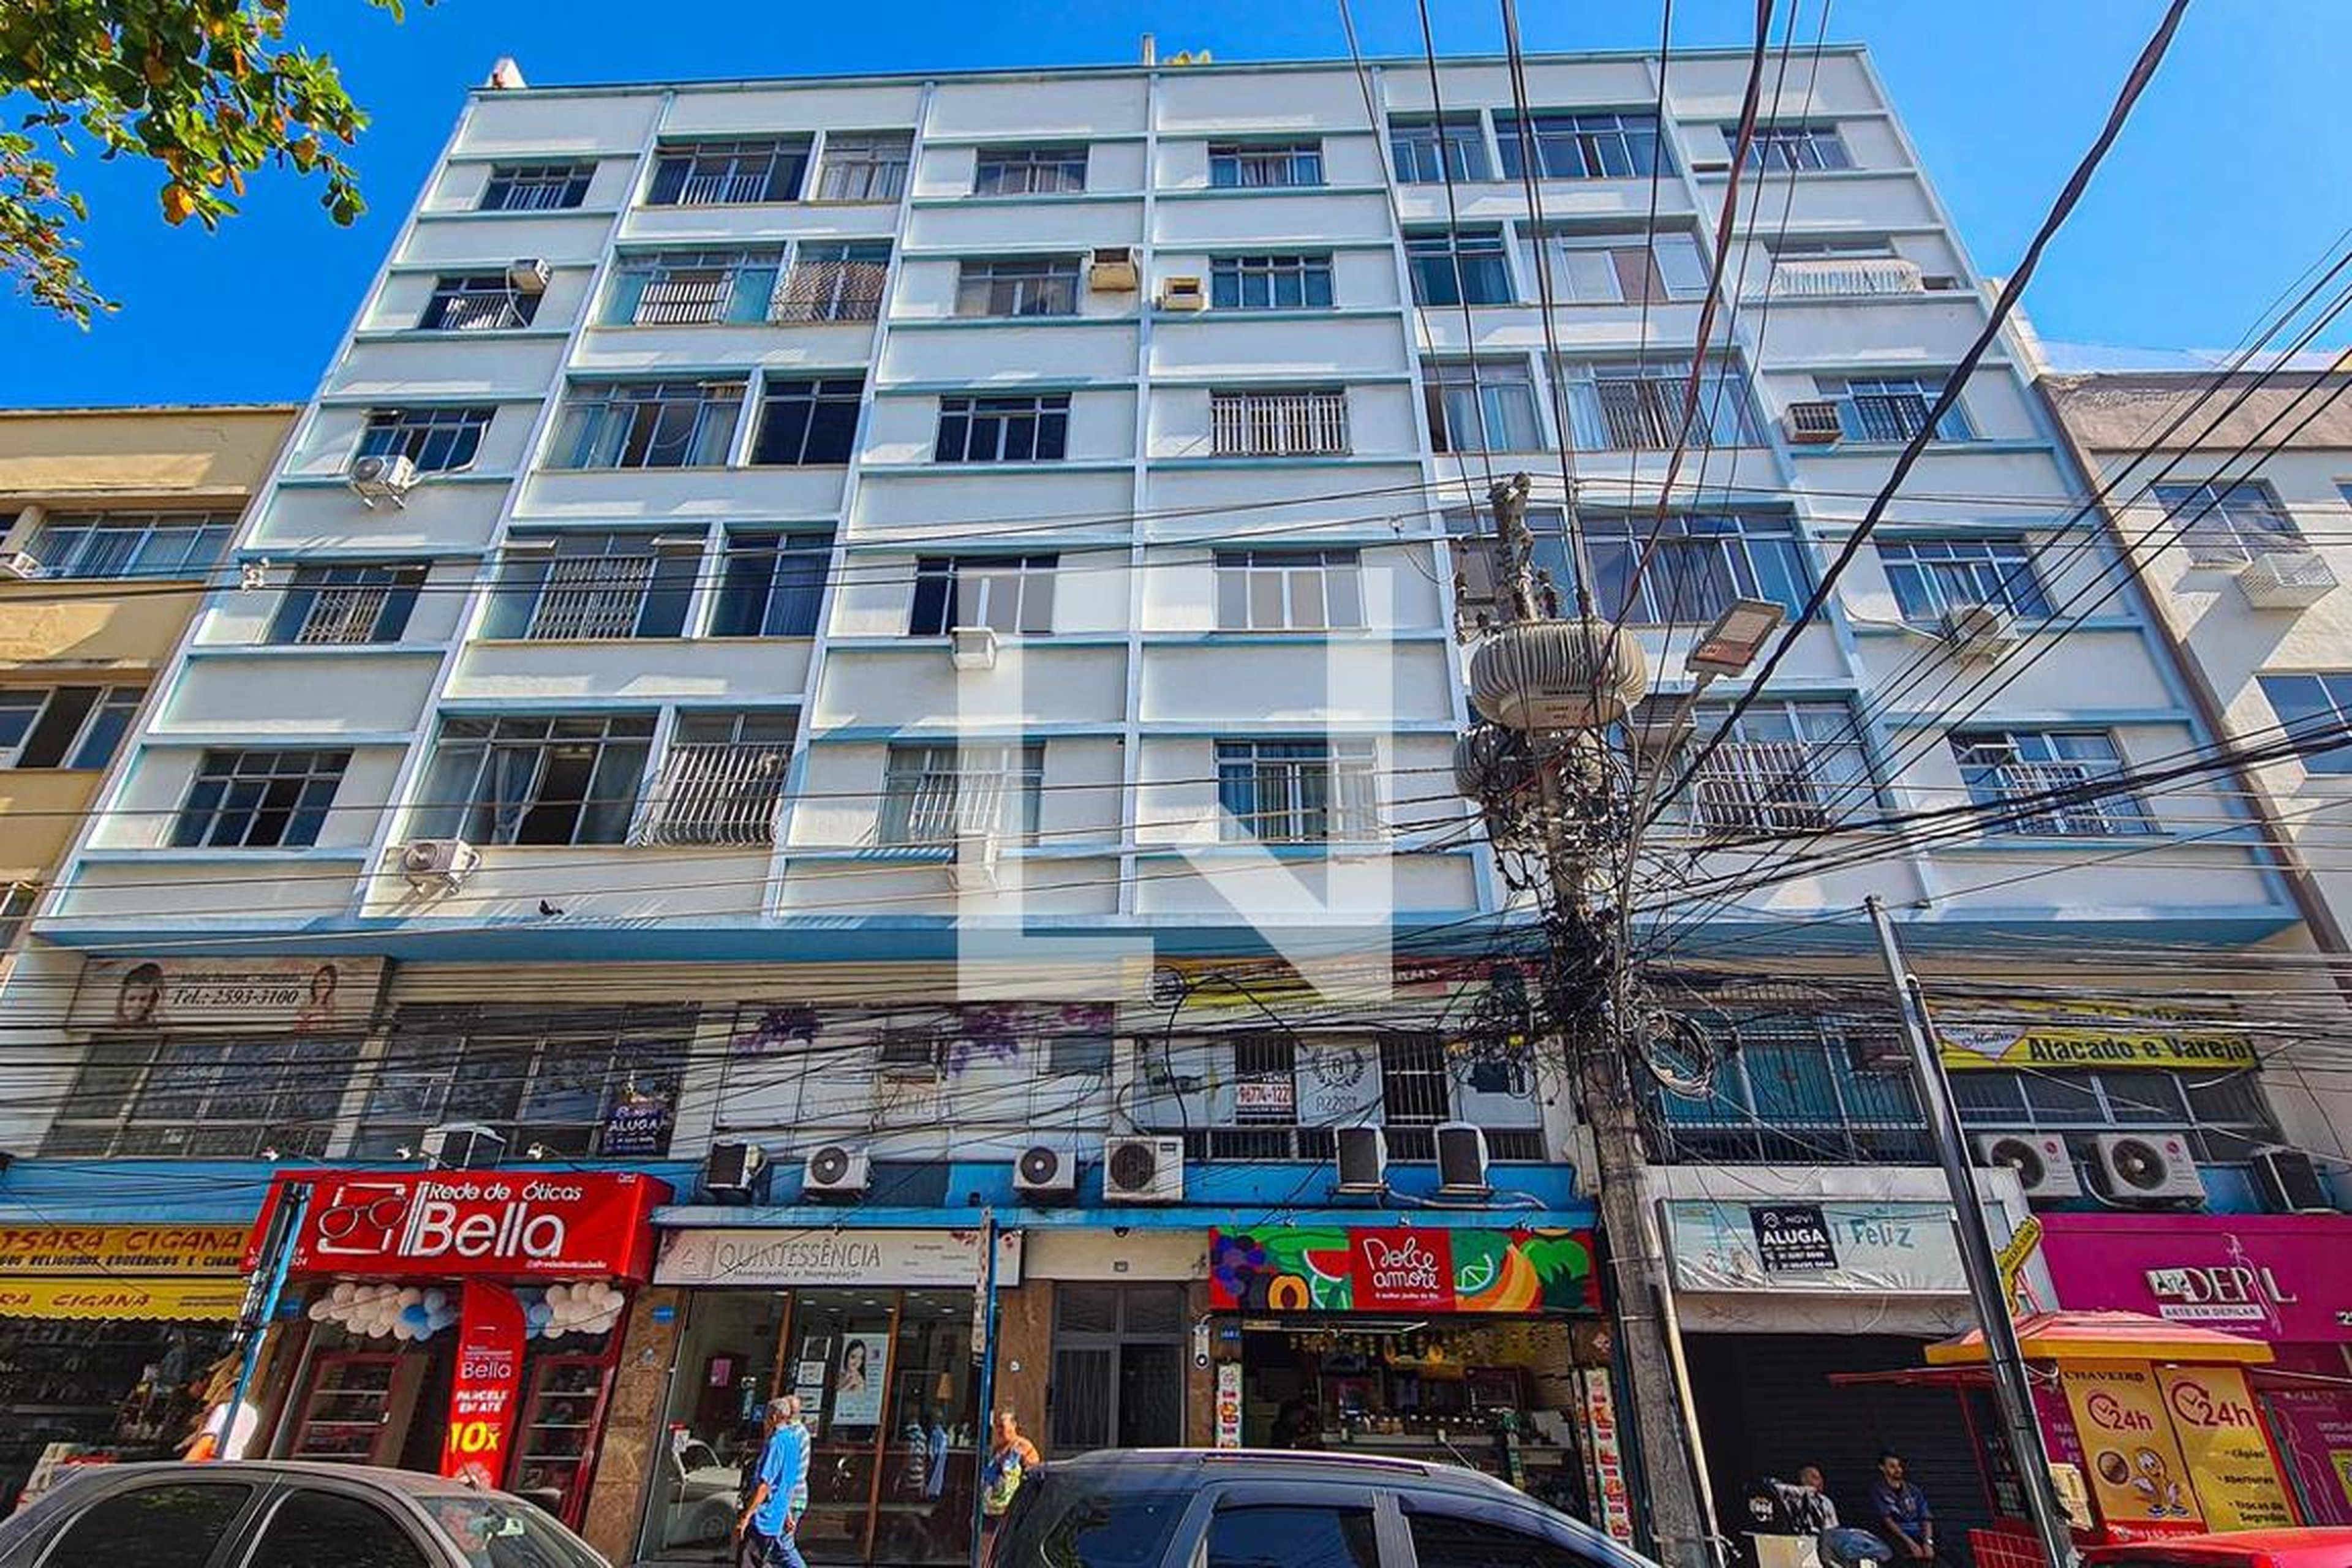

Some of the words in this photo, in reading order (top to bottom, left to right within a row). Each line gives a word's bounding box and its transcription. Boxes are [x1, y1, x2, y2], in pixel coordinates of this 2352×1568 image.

[2029, 1037, 2136, 1061] Atacado
[2143, 1039, 2160, 1058] e
[429, 1183, 481, 1200] Rede
[484, 1183, 511, 1200] de
[522, 1181, 582, 1201] Óticas
[409, 1201, 565, 1258] Bella
[1763, 1228, 1826, 1245] ALUGA
[124, 1230, 243, 1251] CIGANA
[718, 1238, 881, 1270] QUINTESSÊNCIA
[1363, 1236, 1438, 1272] Dolce
[1373, 1269, 1441, 1289] amore
[53, 1293, 151, 1306] CIGANA
[462, 1361, 511, 1379] Bella
[2109, 1410, 2153, 1431] 24h
[2198, 1401, 2255, 1427] 24h
